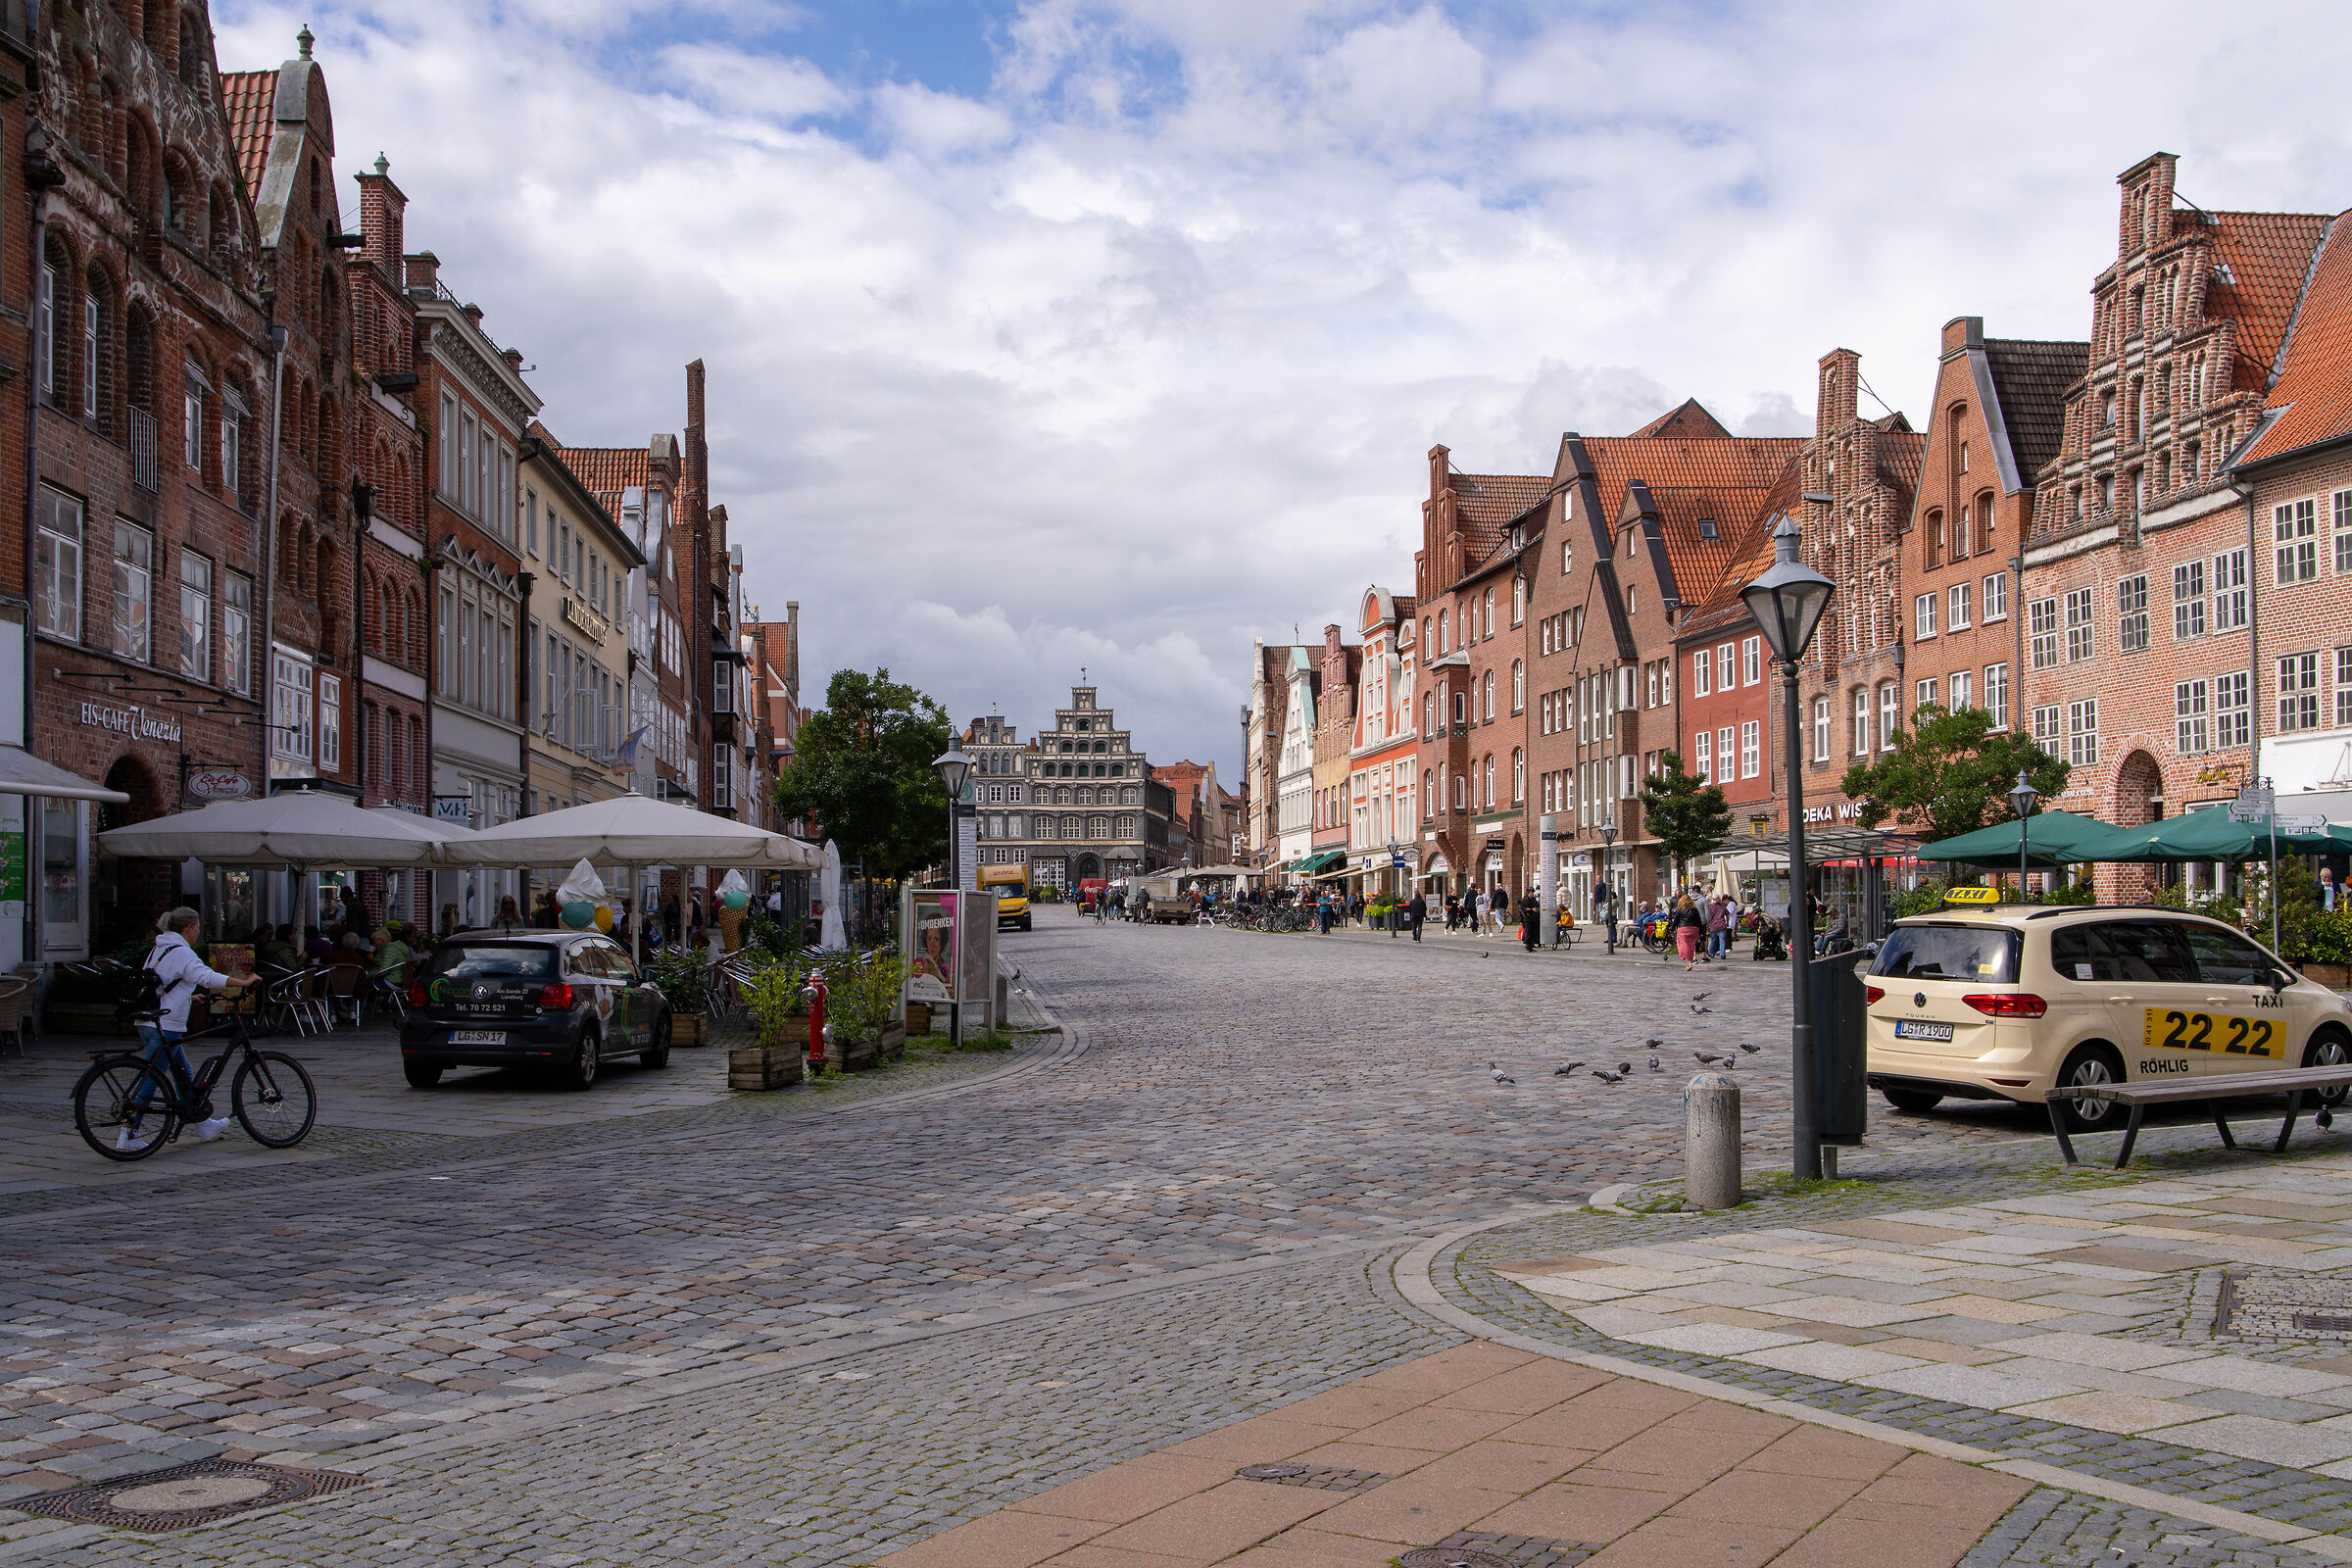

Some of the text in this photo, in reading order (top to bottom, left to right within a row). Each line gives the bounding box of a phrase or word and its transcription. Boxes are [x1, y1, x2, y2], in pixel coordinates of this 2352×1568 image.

[80, 702, 181, 743] EIS-CAFE Venezia
[1802, 806, 1832, 824] DEKA
[1754, 822, 1764, 833] E
[1951, 889, 1984, 899] TAXI
[2252, 995, 2283, 1008] TAXI
[458, 1031, 504, 1042] LG SN 17
[1901, 1022, 1950, 1038] LG R 1900
[2162, 1010, 2273, 1056] 22 22
[2139, 1057, 2189, 1074] RÖHLIG
